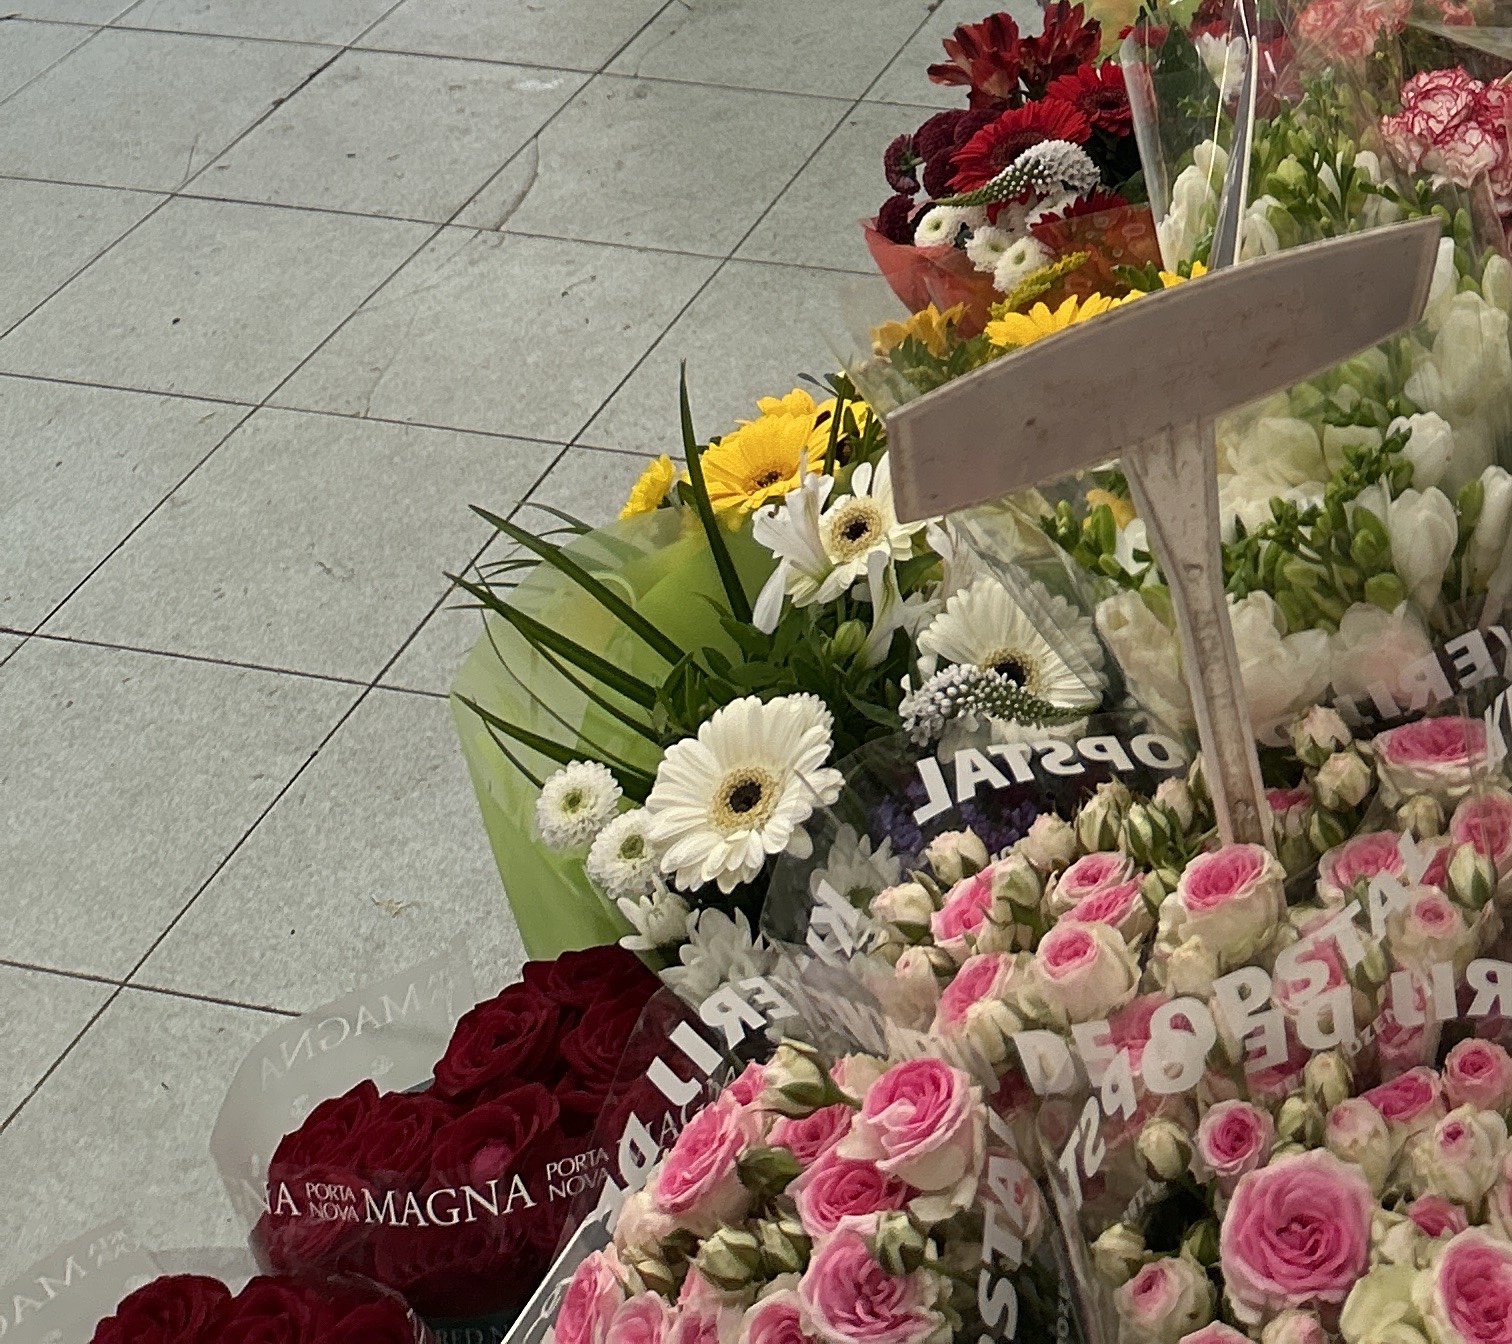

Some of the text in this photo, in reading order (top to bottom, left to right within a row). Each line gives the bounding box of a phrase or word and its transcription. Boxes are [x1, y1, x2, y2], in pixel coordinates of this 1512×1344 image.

[545, 1147, 610, 1182] PORTA
[305, 1181, 357, 1205] PORTA
[361, 1172, 536, 1229] MAGNA
[547, 1168, 610, 1204] NOVA
[308, 1199, 361, 1225] NOVA
